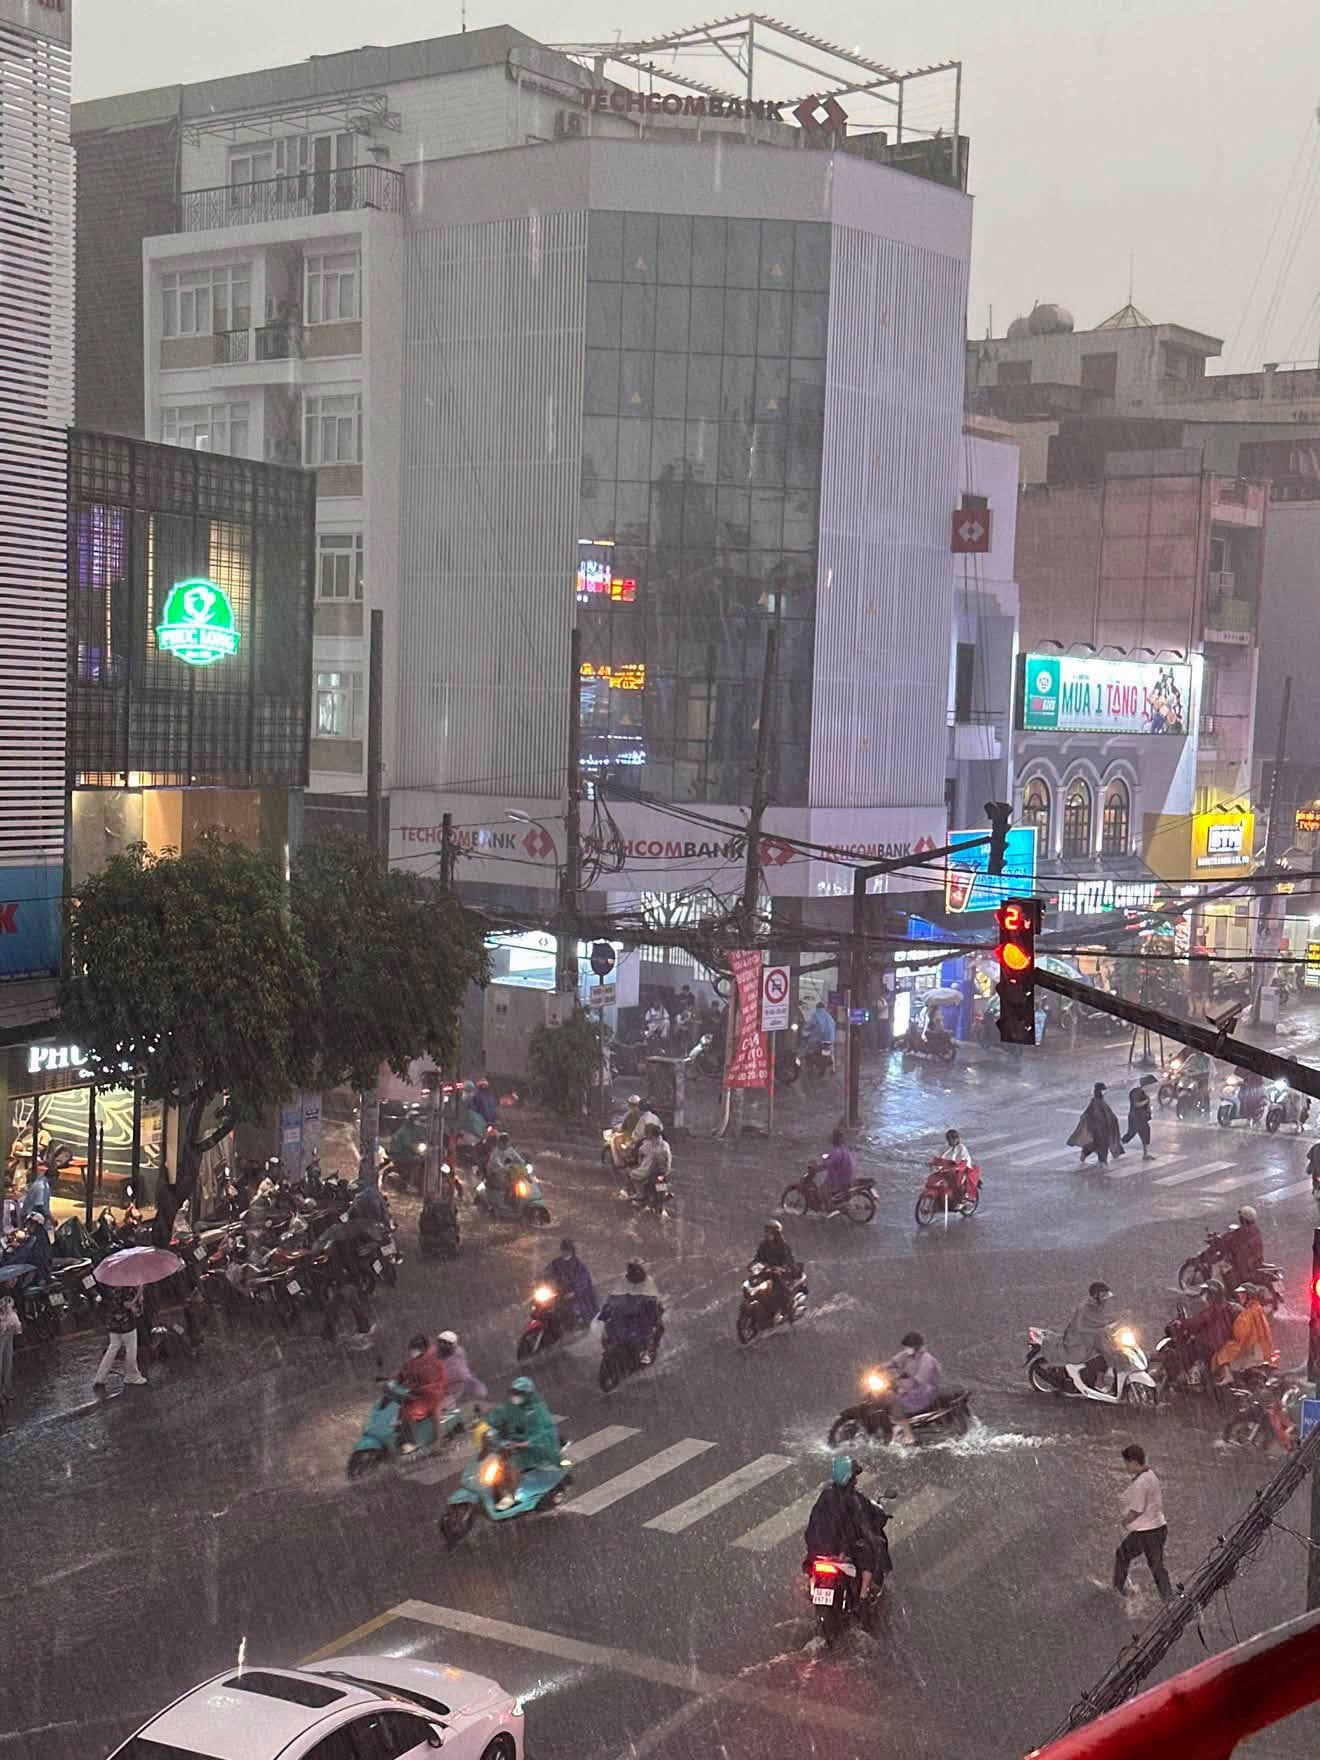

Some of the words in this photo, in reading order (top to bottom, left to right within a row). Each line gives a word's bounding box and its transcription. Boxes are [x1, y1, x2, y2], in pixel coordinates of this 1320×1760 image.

[582, 88, 785, 122] TECHCOMBANK
[1062, 680, 1091, 714] MUA
[1095, 683, 1103, 713] 1
[582, 838, 746, 859] ECHCOMBANK
[1004, 907, 1019, 930] 2
